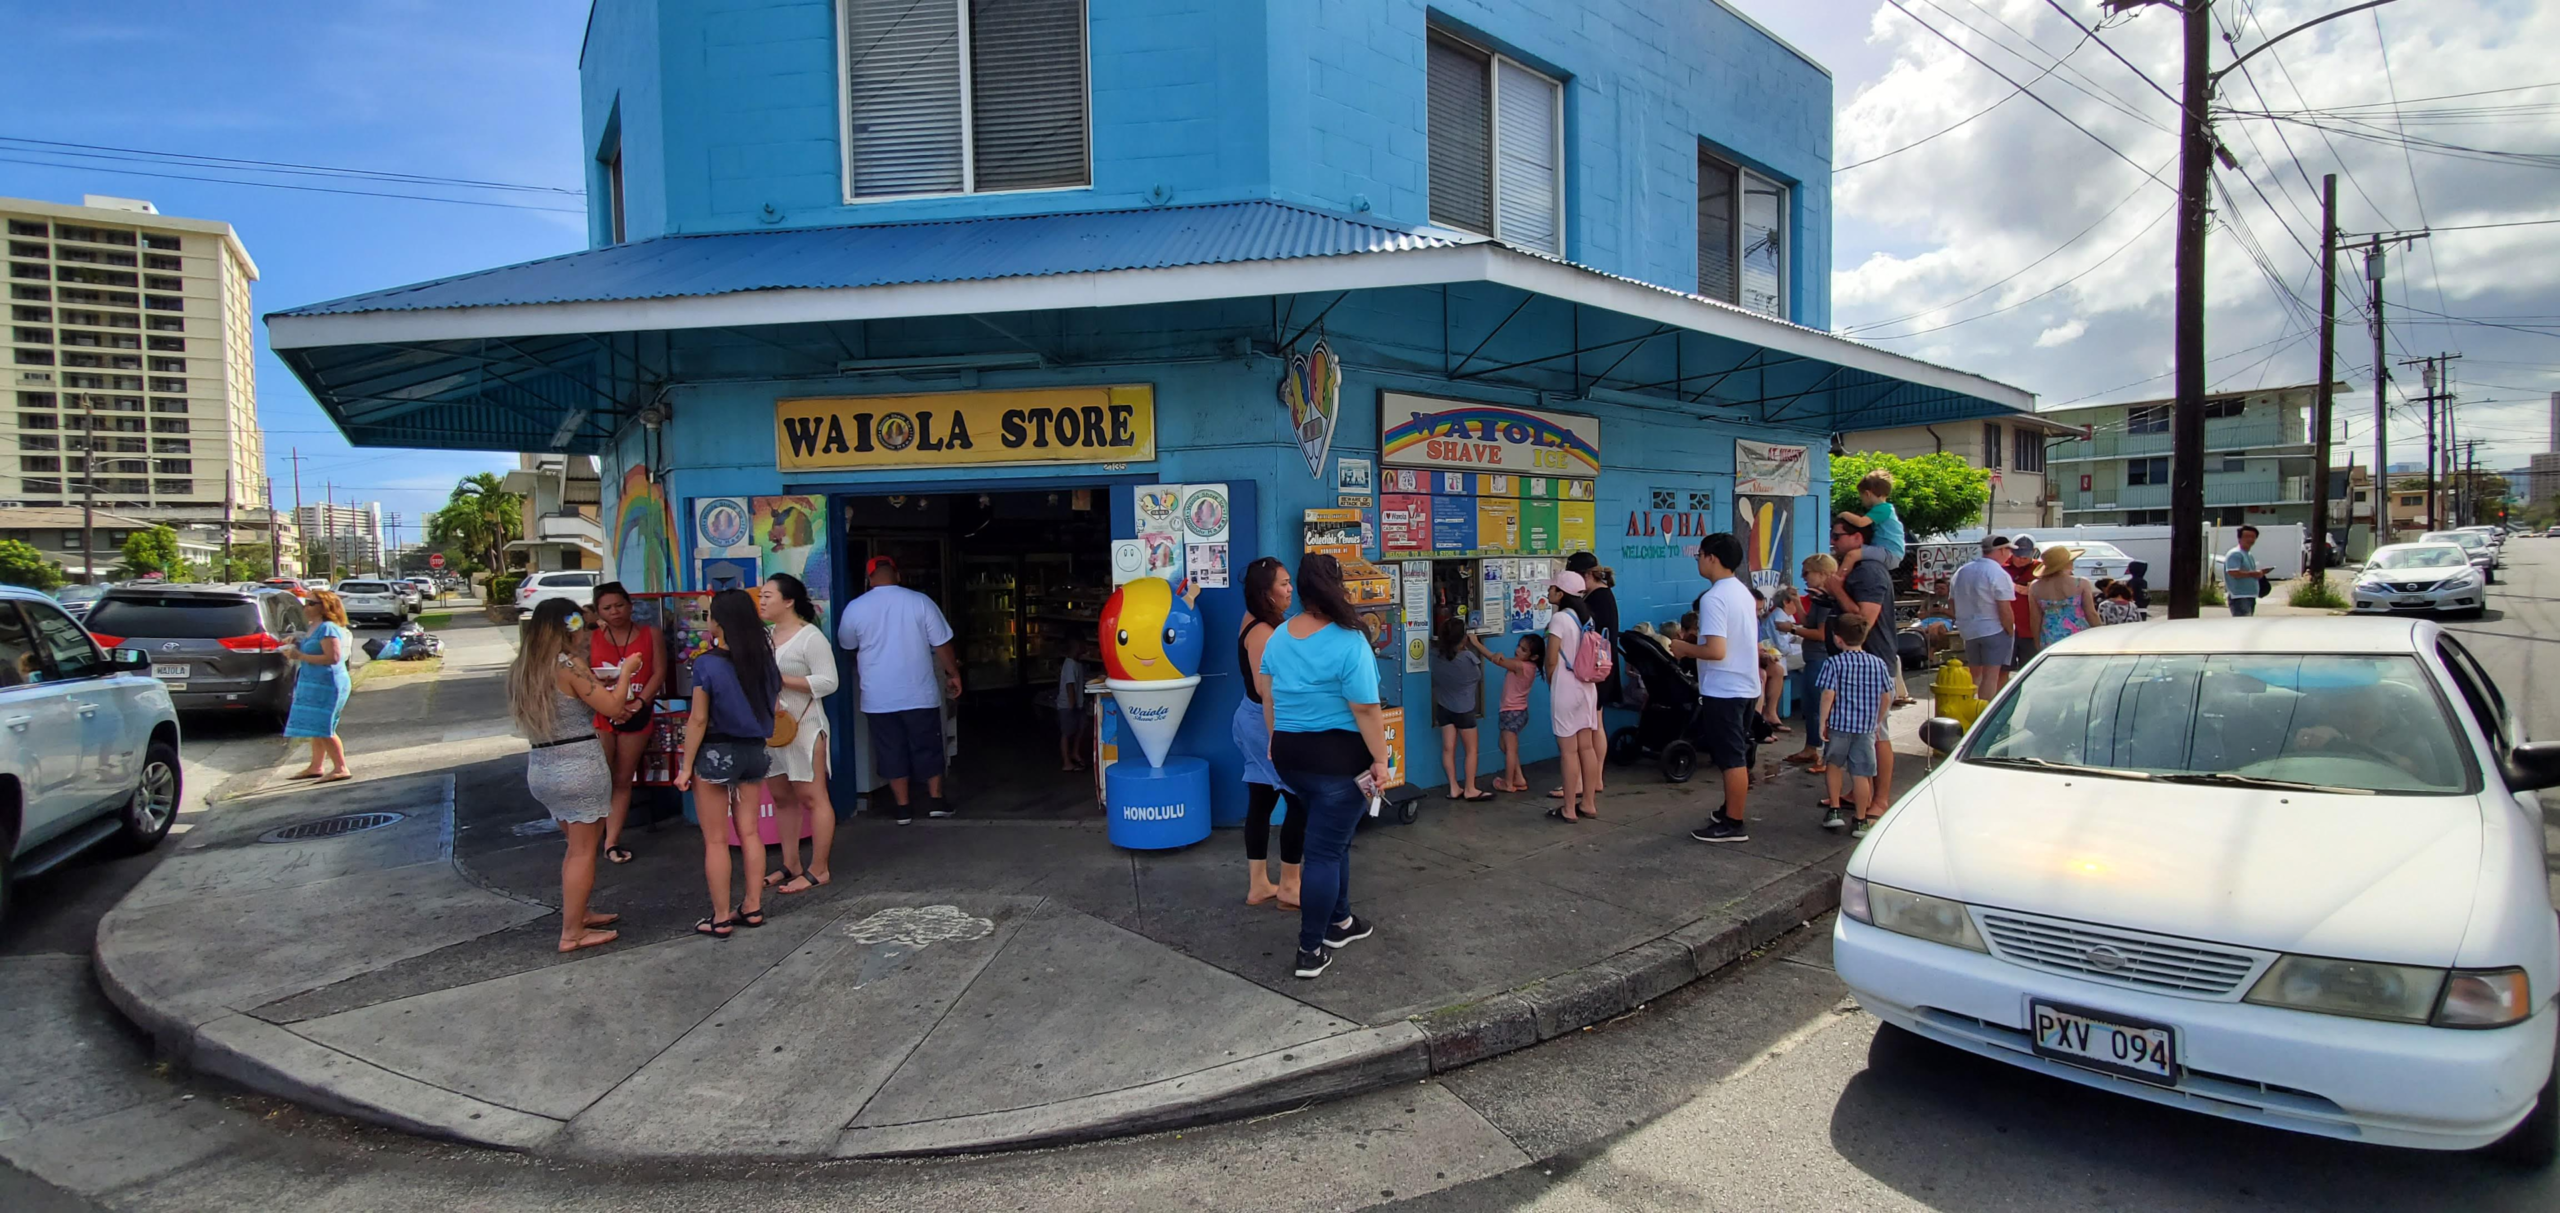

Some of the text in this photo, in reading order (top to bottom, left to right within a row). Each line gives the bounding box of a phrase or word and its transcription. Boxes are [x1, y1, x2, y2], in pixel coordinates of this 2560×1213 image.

[783, 404, 1135, 458] WAIOLA STORE
[1410, 411, 1581, 449] WAIOLA
[1426, 440, 1568, 469] SHAVE ICE
[1626, 511, 1707, 541] ALOHA
[1306, 530, 1361, 545] Collectible Pennies
[1621, 544, 1666, 559] WELCOME
[1667, 544, 1680, 558] TO
[1752, 570, 1779, 589] SHAVE
[156, 666, 186, 675] WAIOLA
[1128, 705, 1170, 718] Waiola
[1154, 714, 1167, 722] Ice
[1123, 803, 1185, 821] HONOLULU
[2038, 1013, 2168, 1071] PXV 094
